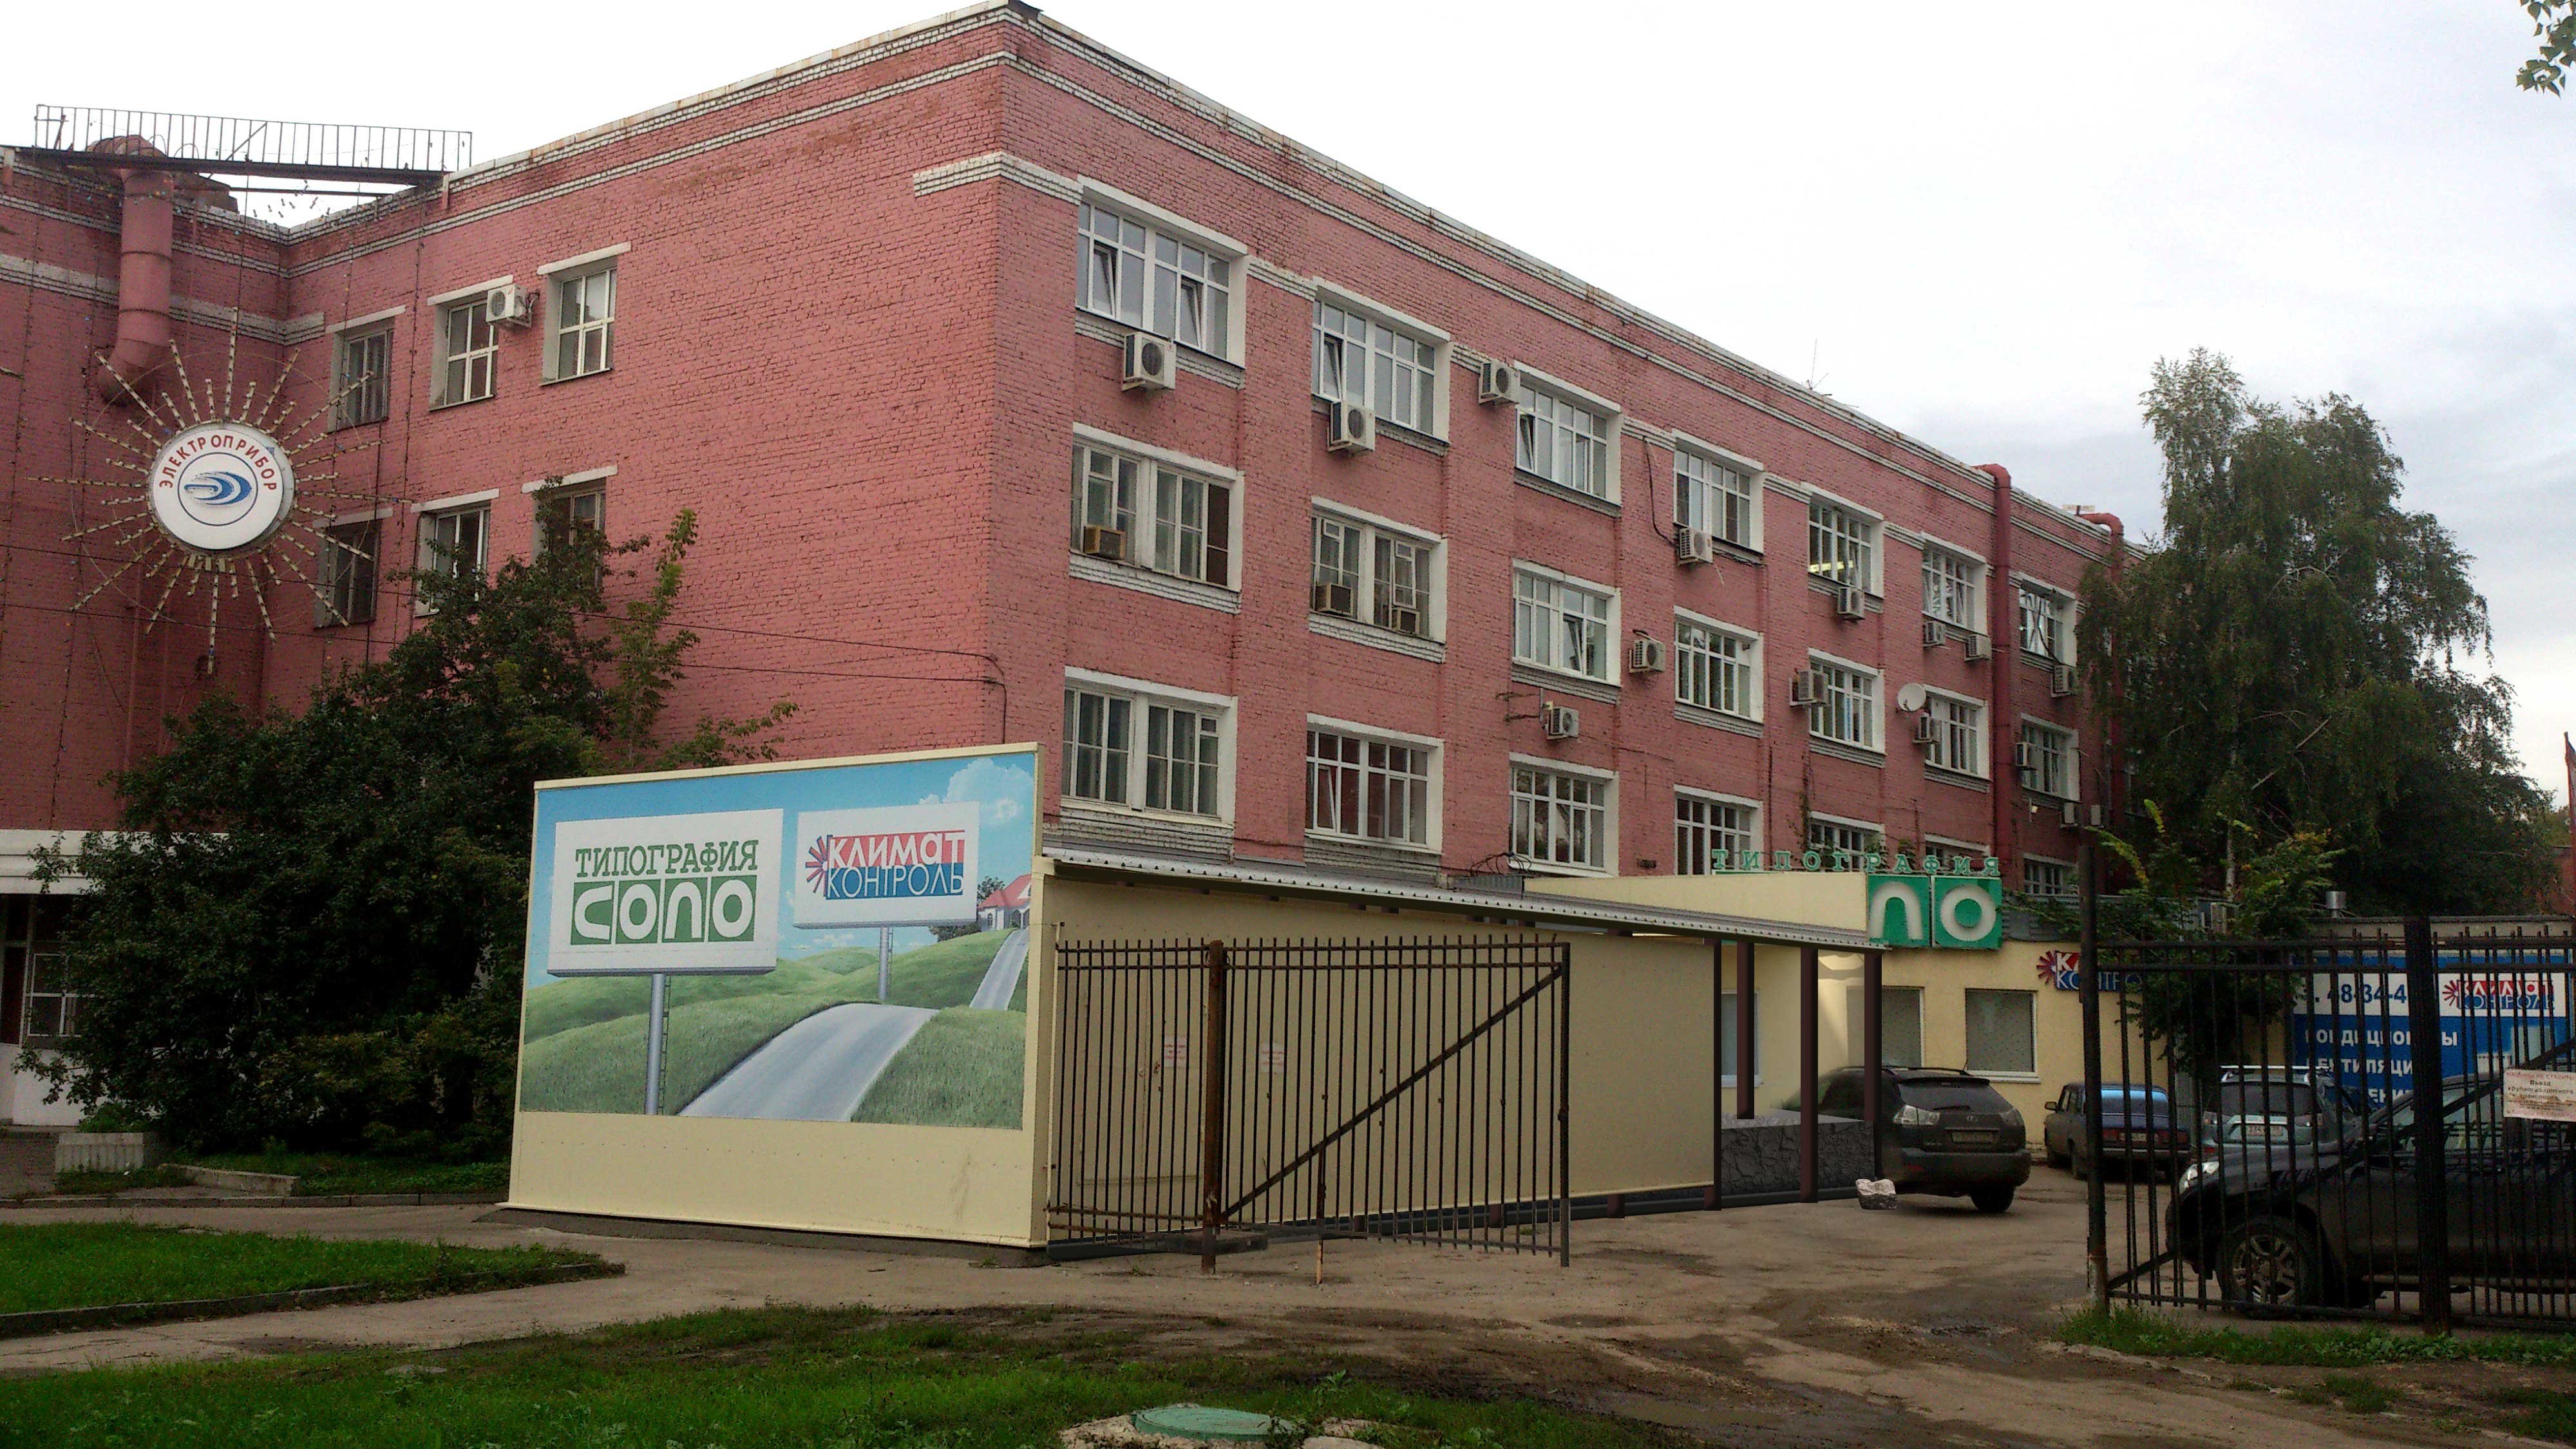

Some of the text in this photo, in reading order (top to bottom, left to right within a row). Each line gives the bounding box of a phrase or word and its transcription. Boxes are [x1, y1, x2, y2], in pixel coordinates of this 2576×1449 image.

[159, 435, 277, 491] ЭЛЕКТРОПРИБОР
[575, 840, 759, 877] ТИПОГРАФИЯ
[1710, 848, 2001, 876] ТИПОГРАФИЯ
[828, 863, 964, 898] КОНТРОЛЬ
